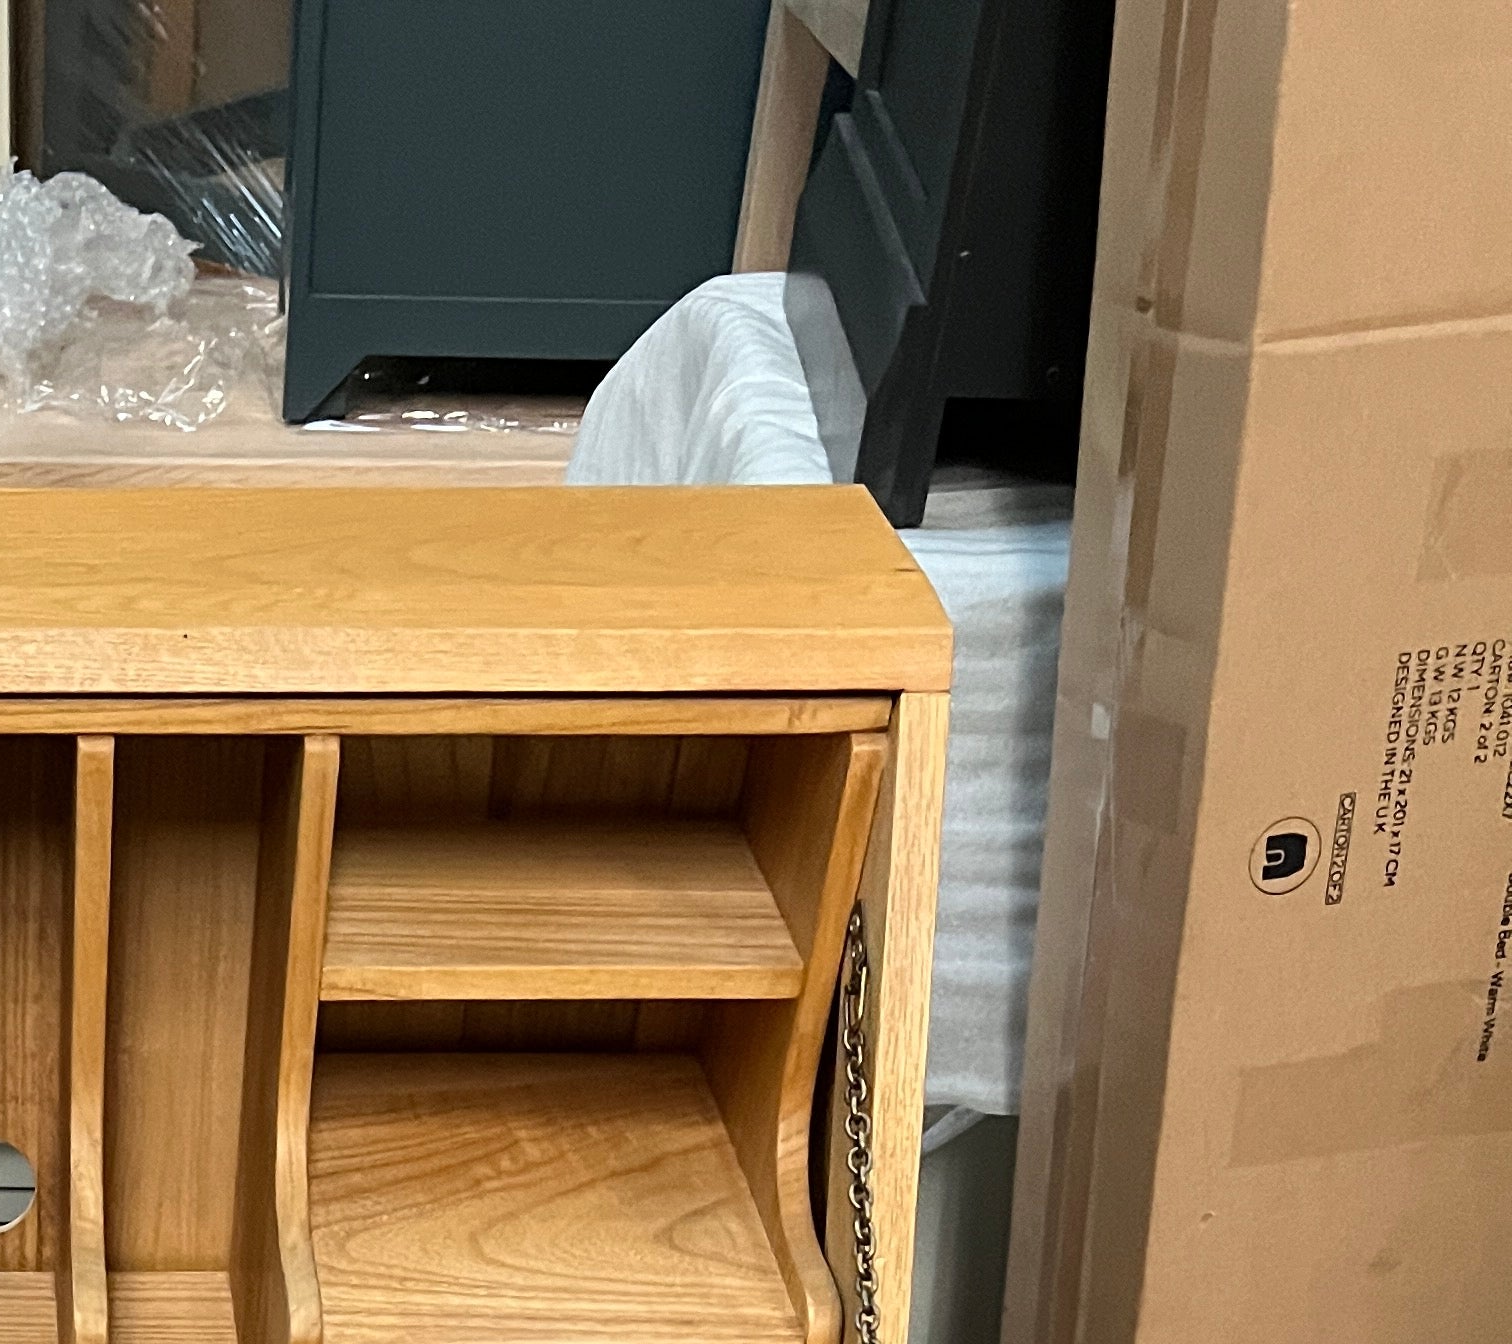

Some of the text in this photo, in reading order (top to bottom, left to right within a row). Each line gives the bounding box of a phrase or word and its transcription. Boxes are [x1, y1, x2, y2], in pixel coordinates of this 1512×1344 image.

[1387, 652, 1412, 744] DESIGNED
[1429, 690, 1443, 706] 13
[1448, 688, 1462, 703] 12
[1479, 721, 1492, 732] 2
[1384, 747, 1397, 765] IN
[1474, 755, 1487, 764] 2
[1399, 768, 1413, 784] 21
[1377, 768, 1396, 803] THE
[1392, 799, 1407, 827] 201
[1333, 795, 1355, 857] CARTON
[1389, 841, 1401, 855] 17
[1383, 859, 1399, 887] CM
[1495, 930, 1512, 959] Bed
